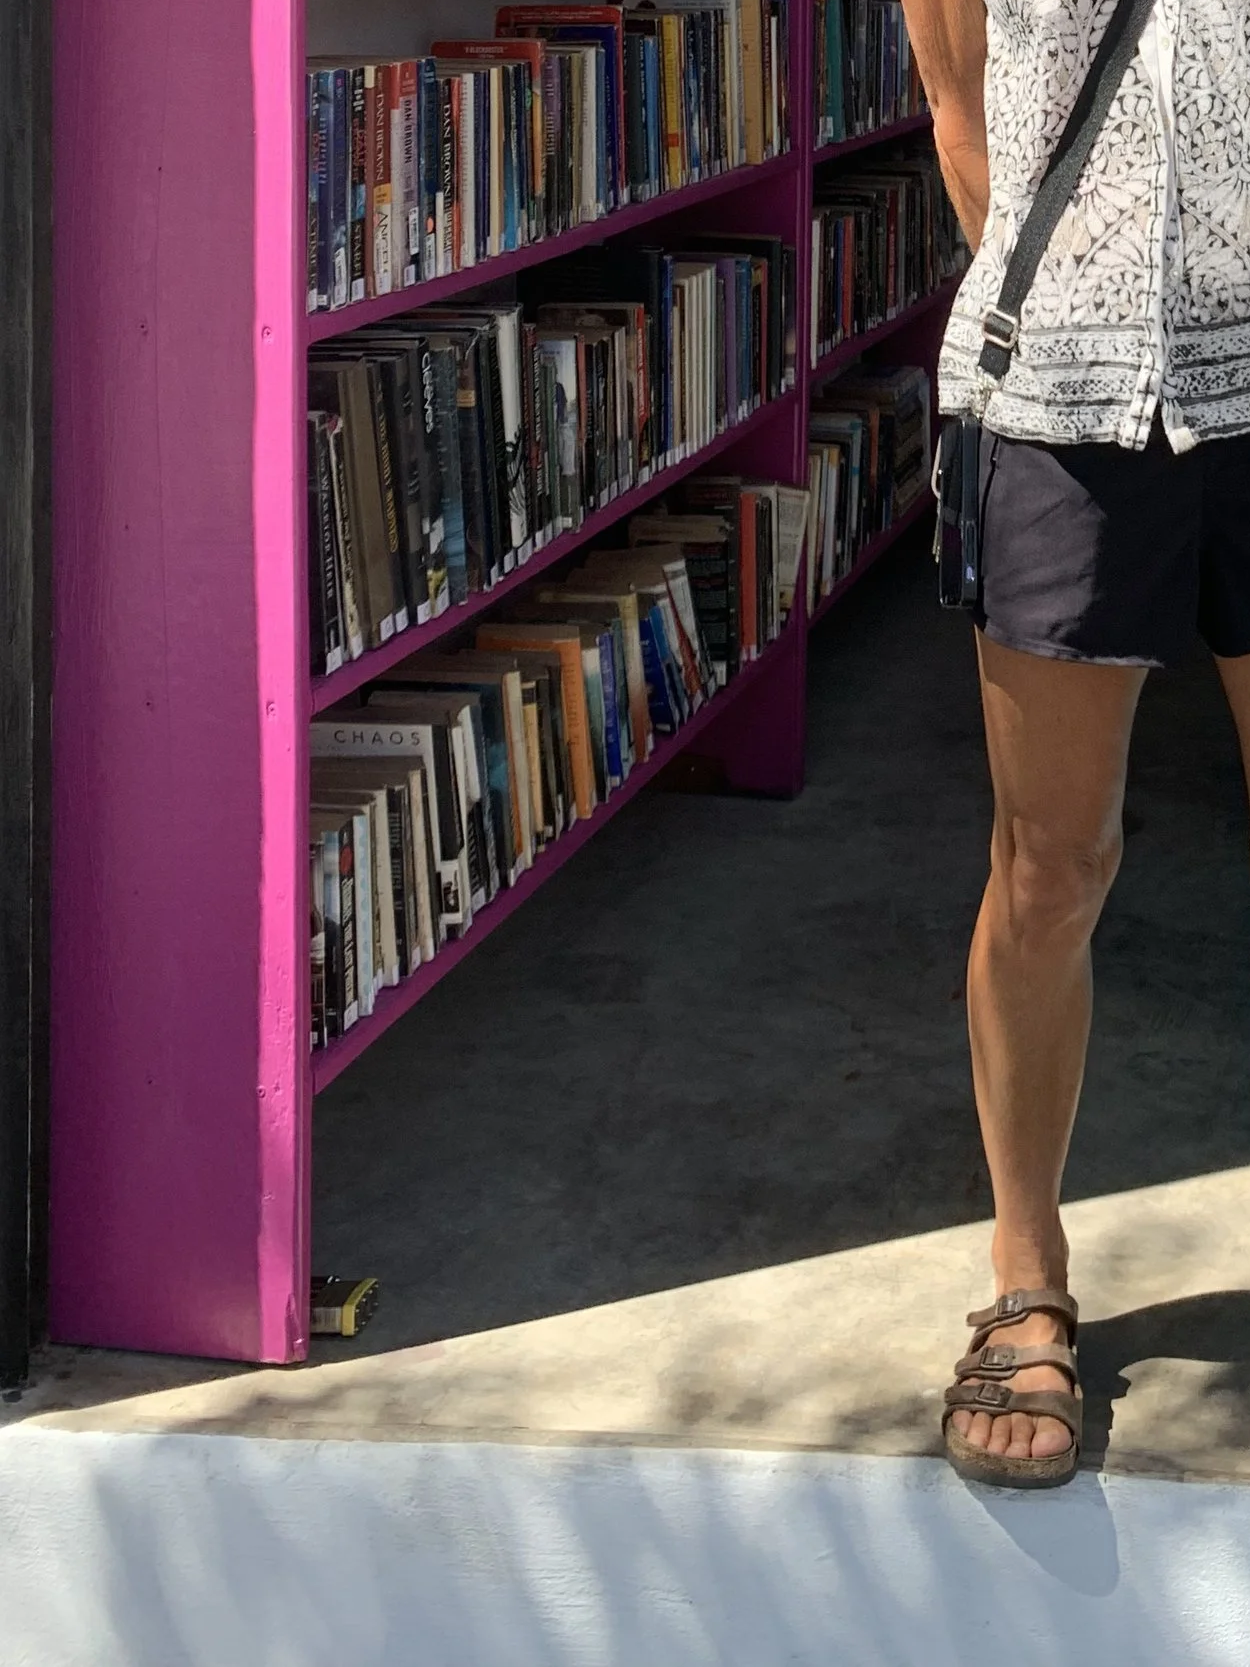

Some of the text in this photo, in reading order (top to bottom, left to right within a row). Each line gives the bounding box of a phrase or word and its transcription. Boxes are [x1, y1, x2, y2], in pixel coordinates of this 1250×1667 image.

[375, 93, 386, 182] DAN BROWN
[404, 98, 413, 165] DAN BROWN
[442, 103, 452, 198] DAN BROWN
[421, 351, 436, 433] cleeves
[333, 729, 421, 746] CHAOS
